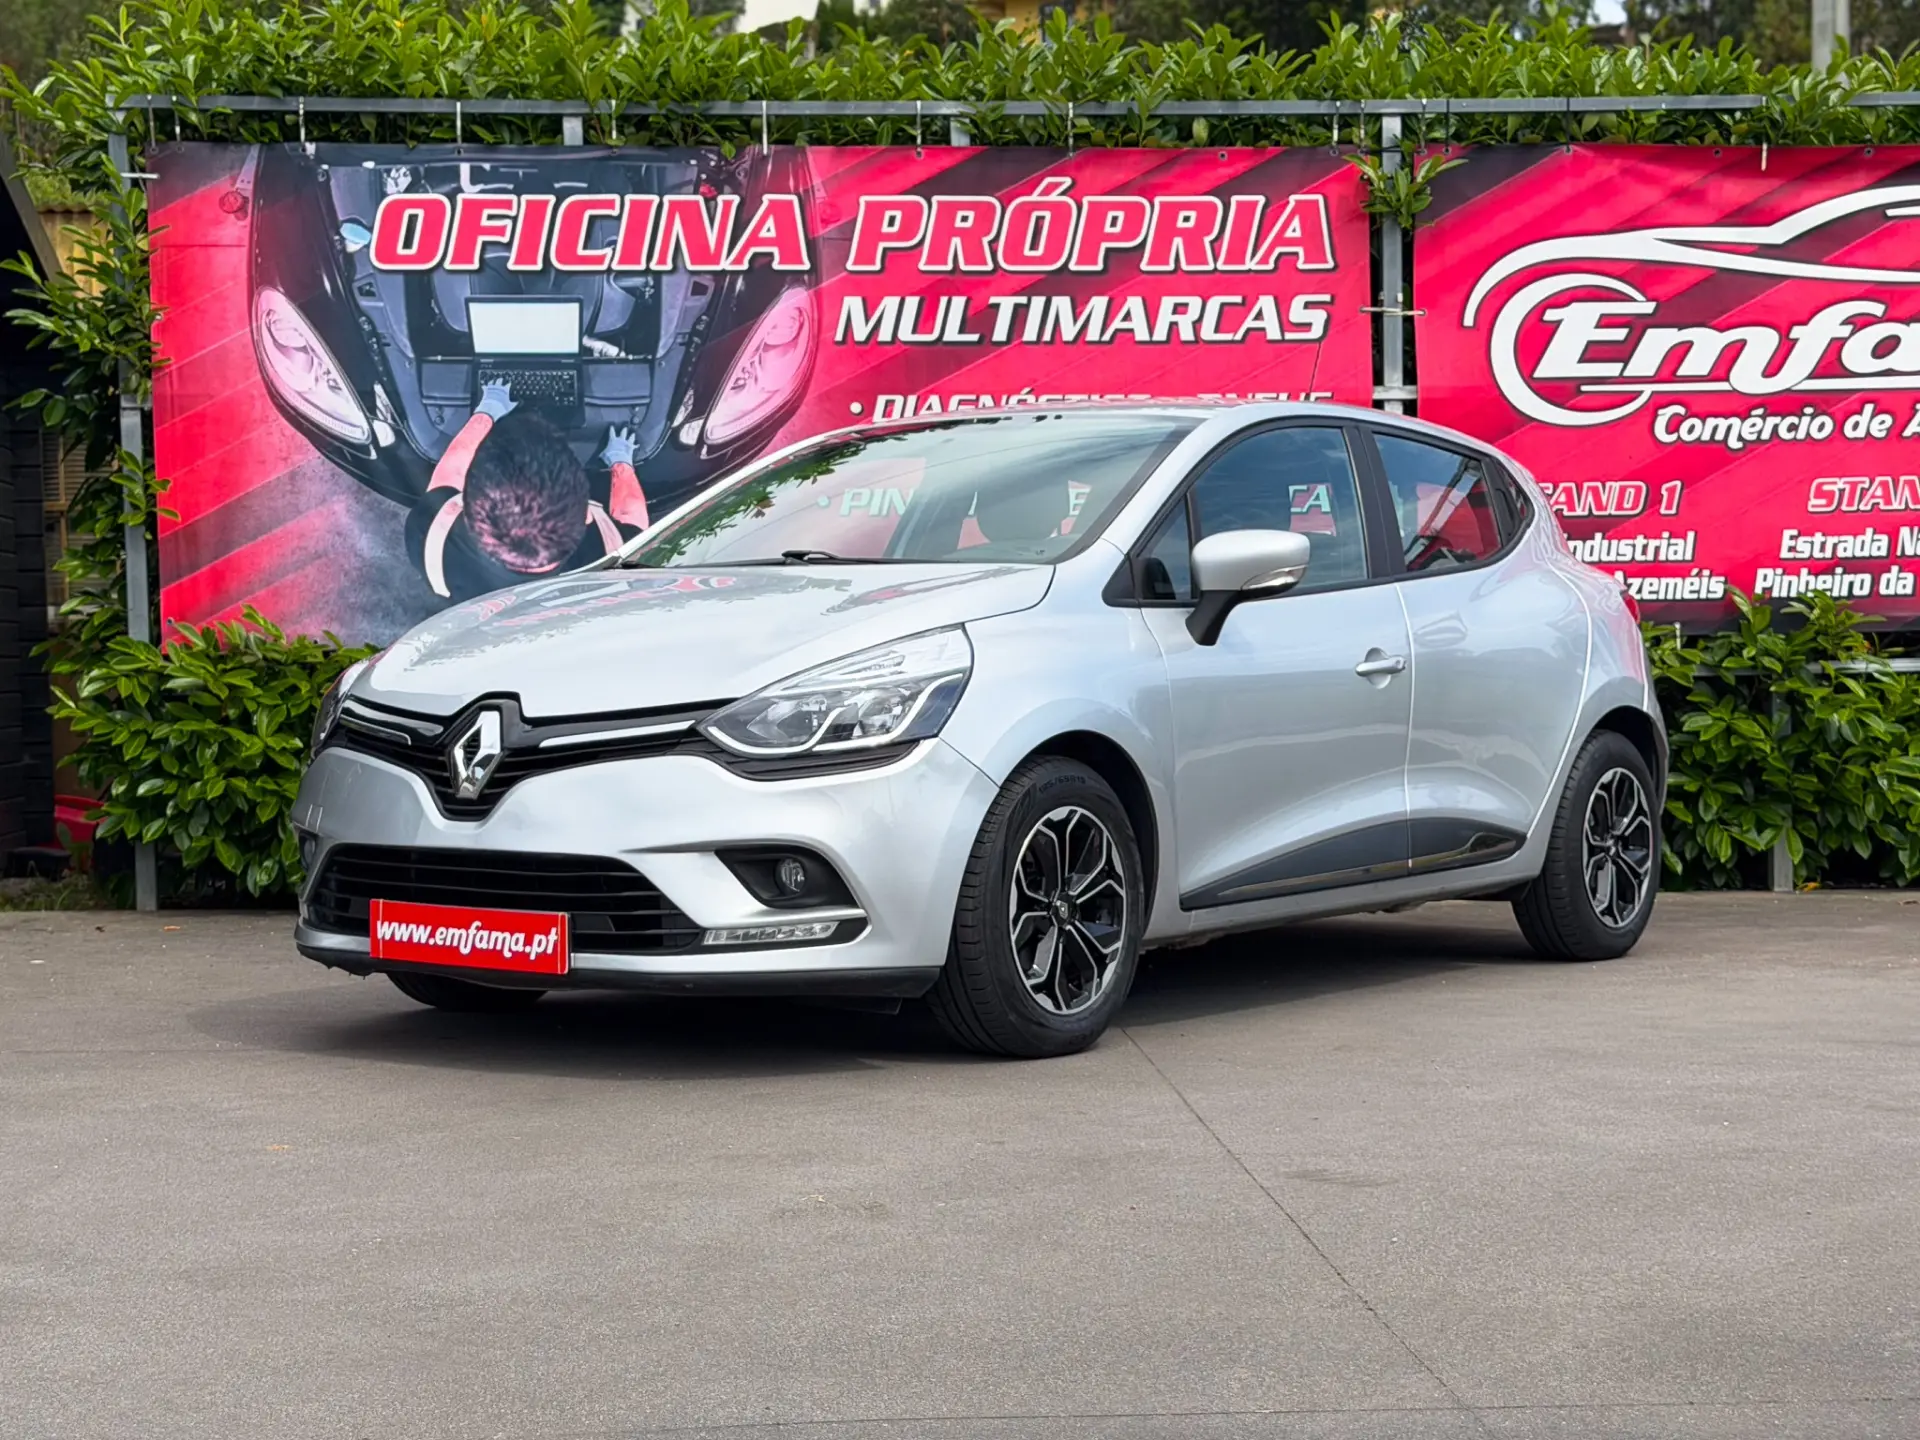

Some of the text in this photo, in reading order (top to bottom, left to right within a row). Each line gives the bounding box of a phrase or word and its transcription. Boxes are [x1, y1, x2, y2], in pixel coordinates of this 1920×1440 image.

[370, 176, 1335, 271] OFICINA PRÓPRIA
[834, 295, 1333, 343] MULTIMARCAS
[1653, 406, 1834, 450] Comércio
[1843, 403, 1892, 438] de
[1660, 480, 1682, 515] 1
[1563, 530, 1696, 562] ndustrial
[1779, 527, 1889, 559] Estrada
[1754, 565, 1914, 598] Pinheiro da
[376, 919, 559, 961] www.emfama.pt
